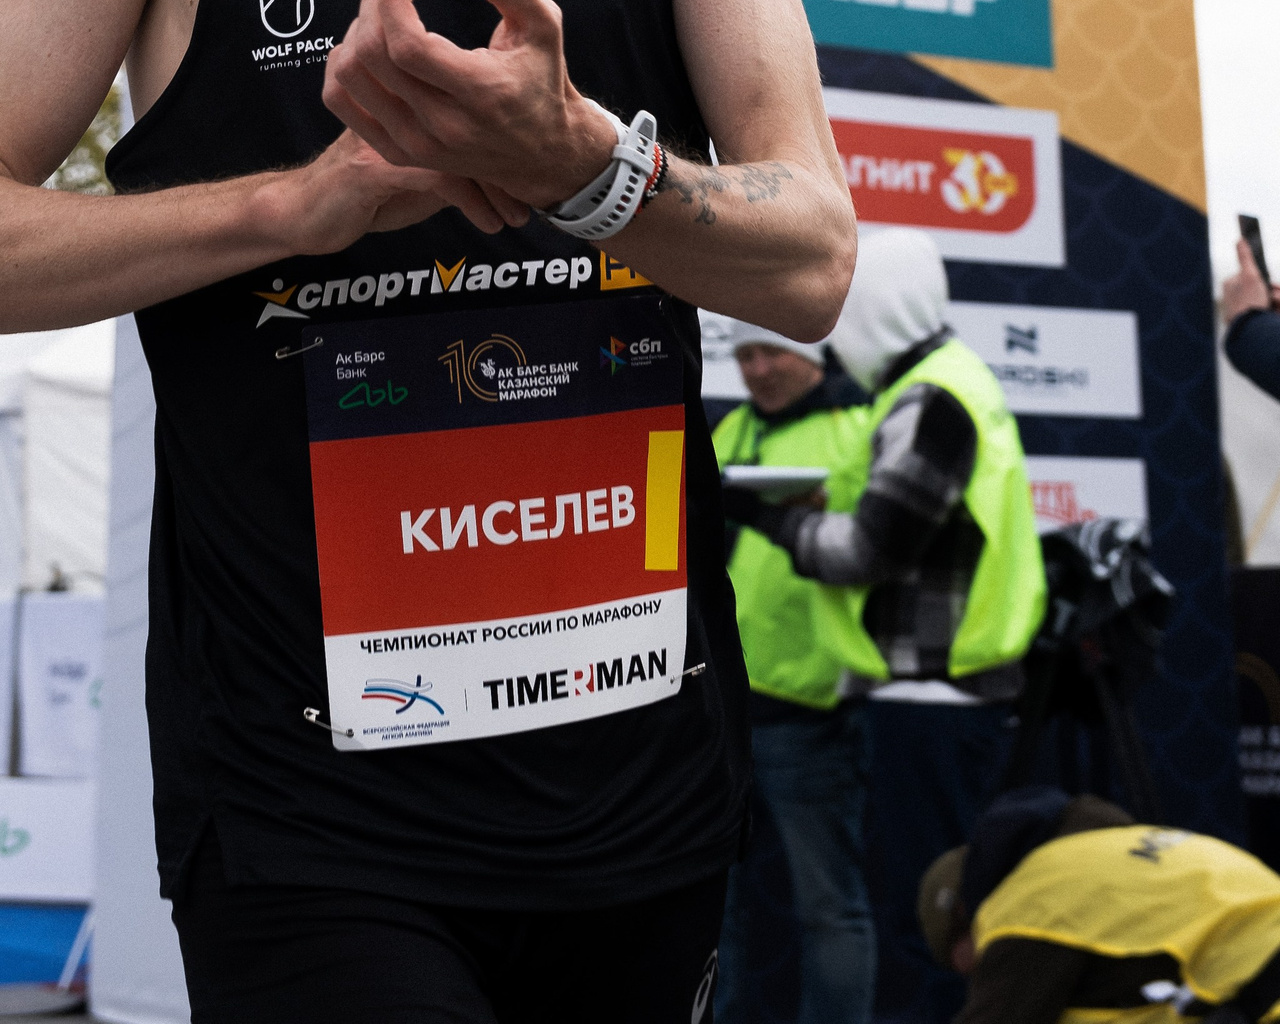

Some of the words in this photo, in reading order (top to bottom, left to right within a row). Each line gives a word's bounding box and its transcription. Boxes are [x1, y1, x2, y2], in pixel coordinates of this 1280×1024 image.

[252, 43, 293, 61] WOLF
[296, 36, 334, 54] PACK
[260, 59, 301, 72] running
[306, 54, 328, 64] club
[629, 337, 662, 355] сбп
[335, 352, 353, 365] Ак
[354, 350, 385, 364] Барс
[336, 367, 367, 380] Банк
[498, 367, 514, 379] АК
[517, 364, 547, 377] БАРС
[550, 361, 579, 374] БАНК
[498, 372, 571, 390] КАЗАНСКИЙ
[499, 386, 557, 401] МАРАФОН
[400, 485, 636, 555] КИСЕЛЕВ
[360, 629, 477, 654] ЧЕМПИОНАТ
[482, 619, 553, 643] РОССИИ
[556, 615, 579, 632] ПО
[582, 598, 662, 628] МАРАФОНУ
[483, 648, 667, 711] TIMERMAN
